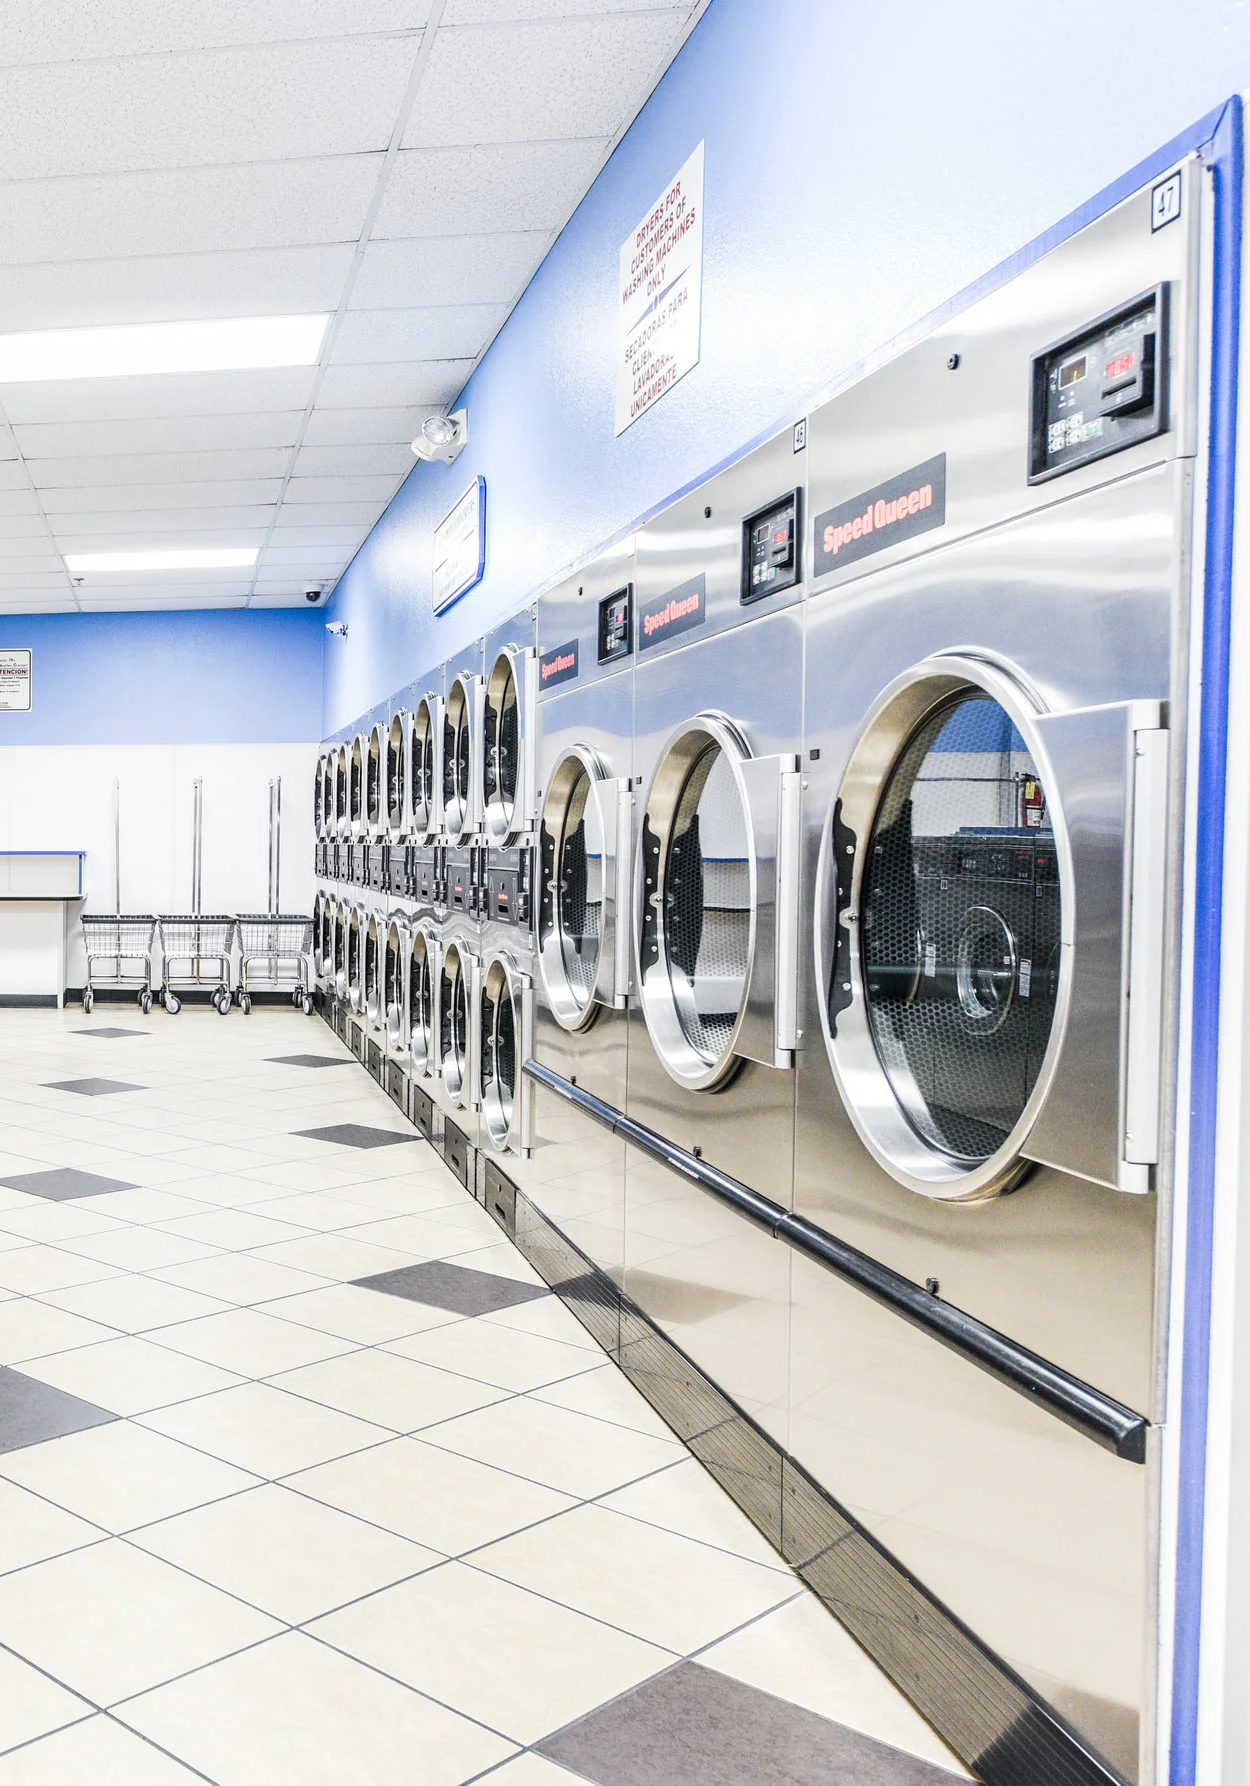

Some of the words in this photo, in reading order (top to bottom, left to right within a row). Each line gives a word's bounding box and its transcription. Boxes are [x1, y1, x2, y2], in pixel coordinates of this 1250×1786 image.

[631, 212, 674, 275] CUSTOMERS
[676, 196, 686, 220] OF
[636, 203, 664, 249] DRYERS
[665, 181, 681, 212] FOR
[1158, 186, 1174, 217] 47
[622, 258, 654, 304] WASHING
[655, 207, 696, 267] MACHINES
[646, 263, 666, 296] ONLY
[625, 309, 666, 364] SECADORAS
[668, 286, 688, 318] PARA
[630, 363, 677, 418] UNICAMENTE
[823, 504, 874, 555] Speed
[874, 484, 933, 529] Queen
[644, 603, 670, 636] Speed
[670, 593, 699, 621] Queen
